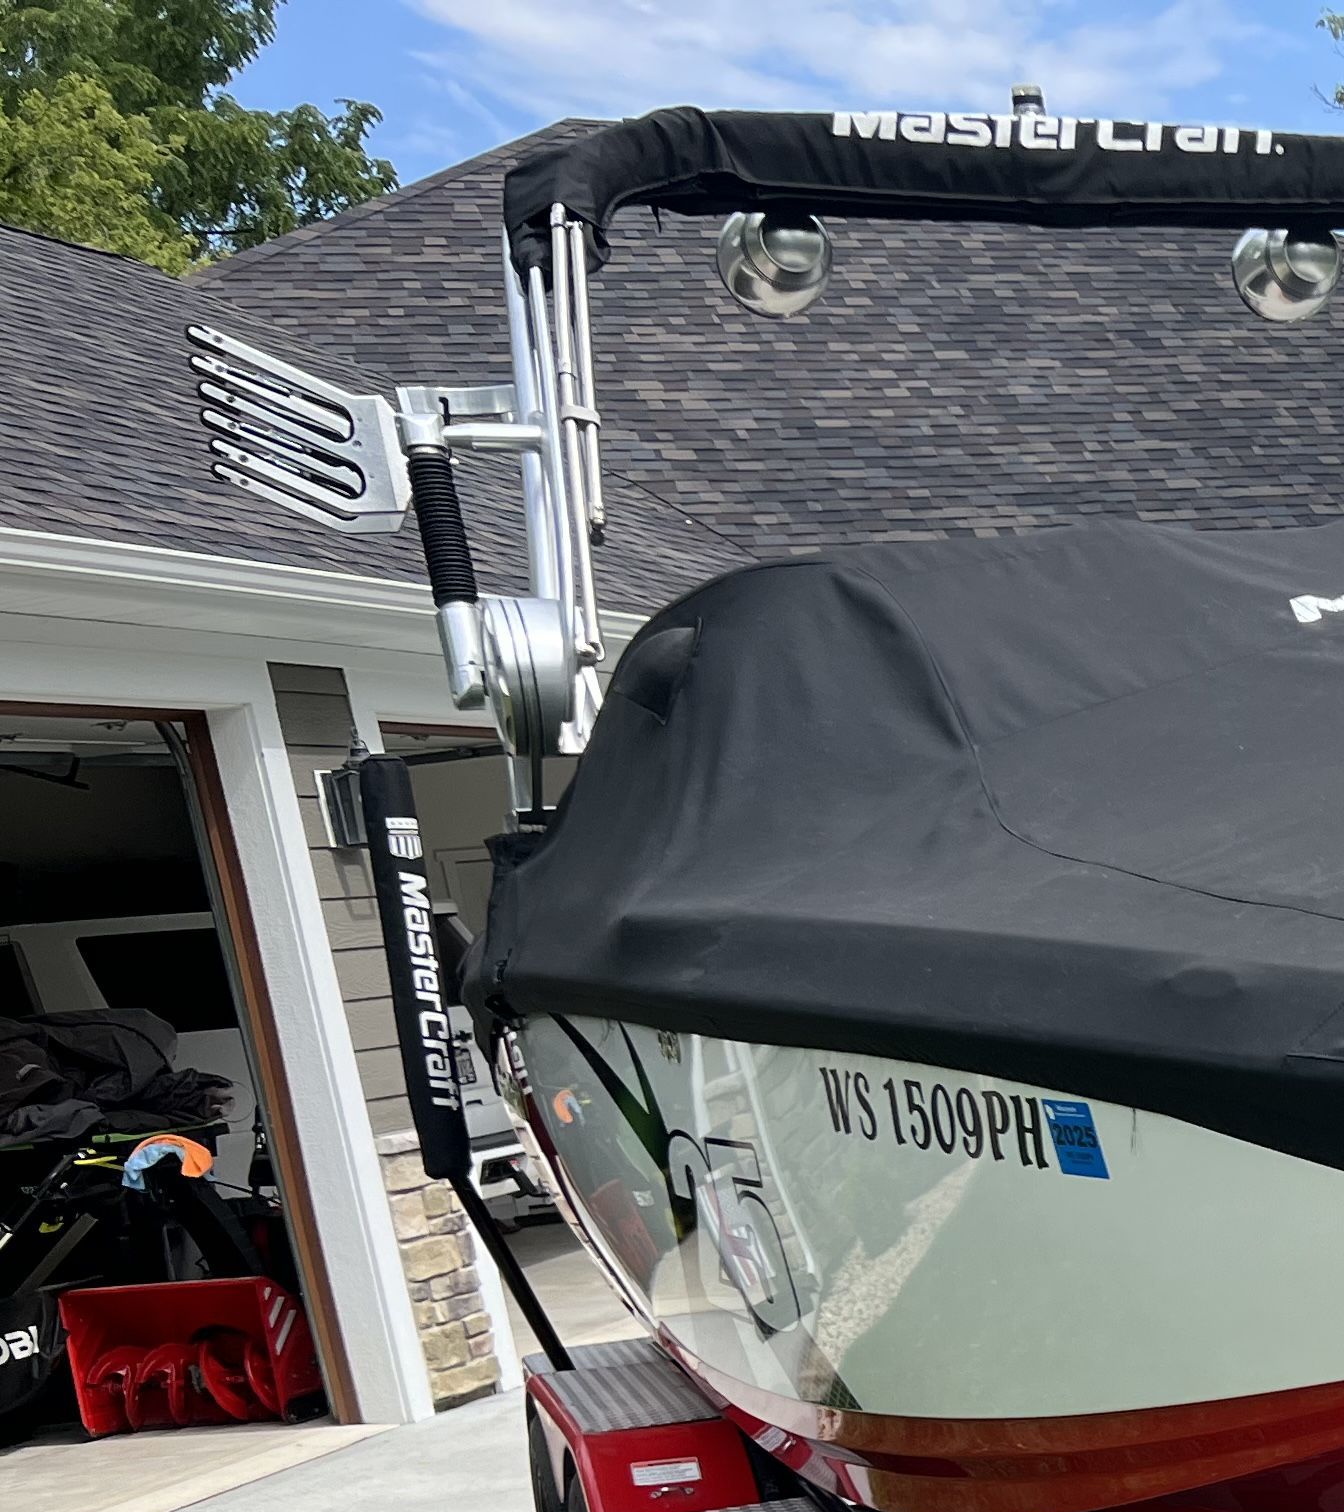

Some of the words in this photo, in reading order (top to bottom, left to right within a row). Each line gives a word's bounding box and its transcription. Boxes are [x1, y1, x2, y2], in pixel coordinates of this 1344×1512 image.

[398, 871, 460, 1112] MasterCraft
[819, 1066, 878, 1141] WS
[1052, 1122, 1098, 1148] 2025
